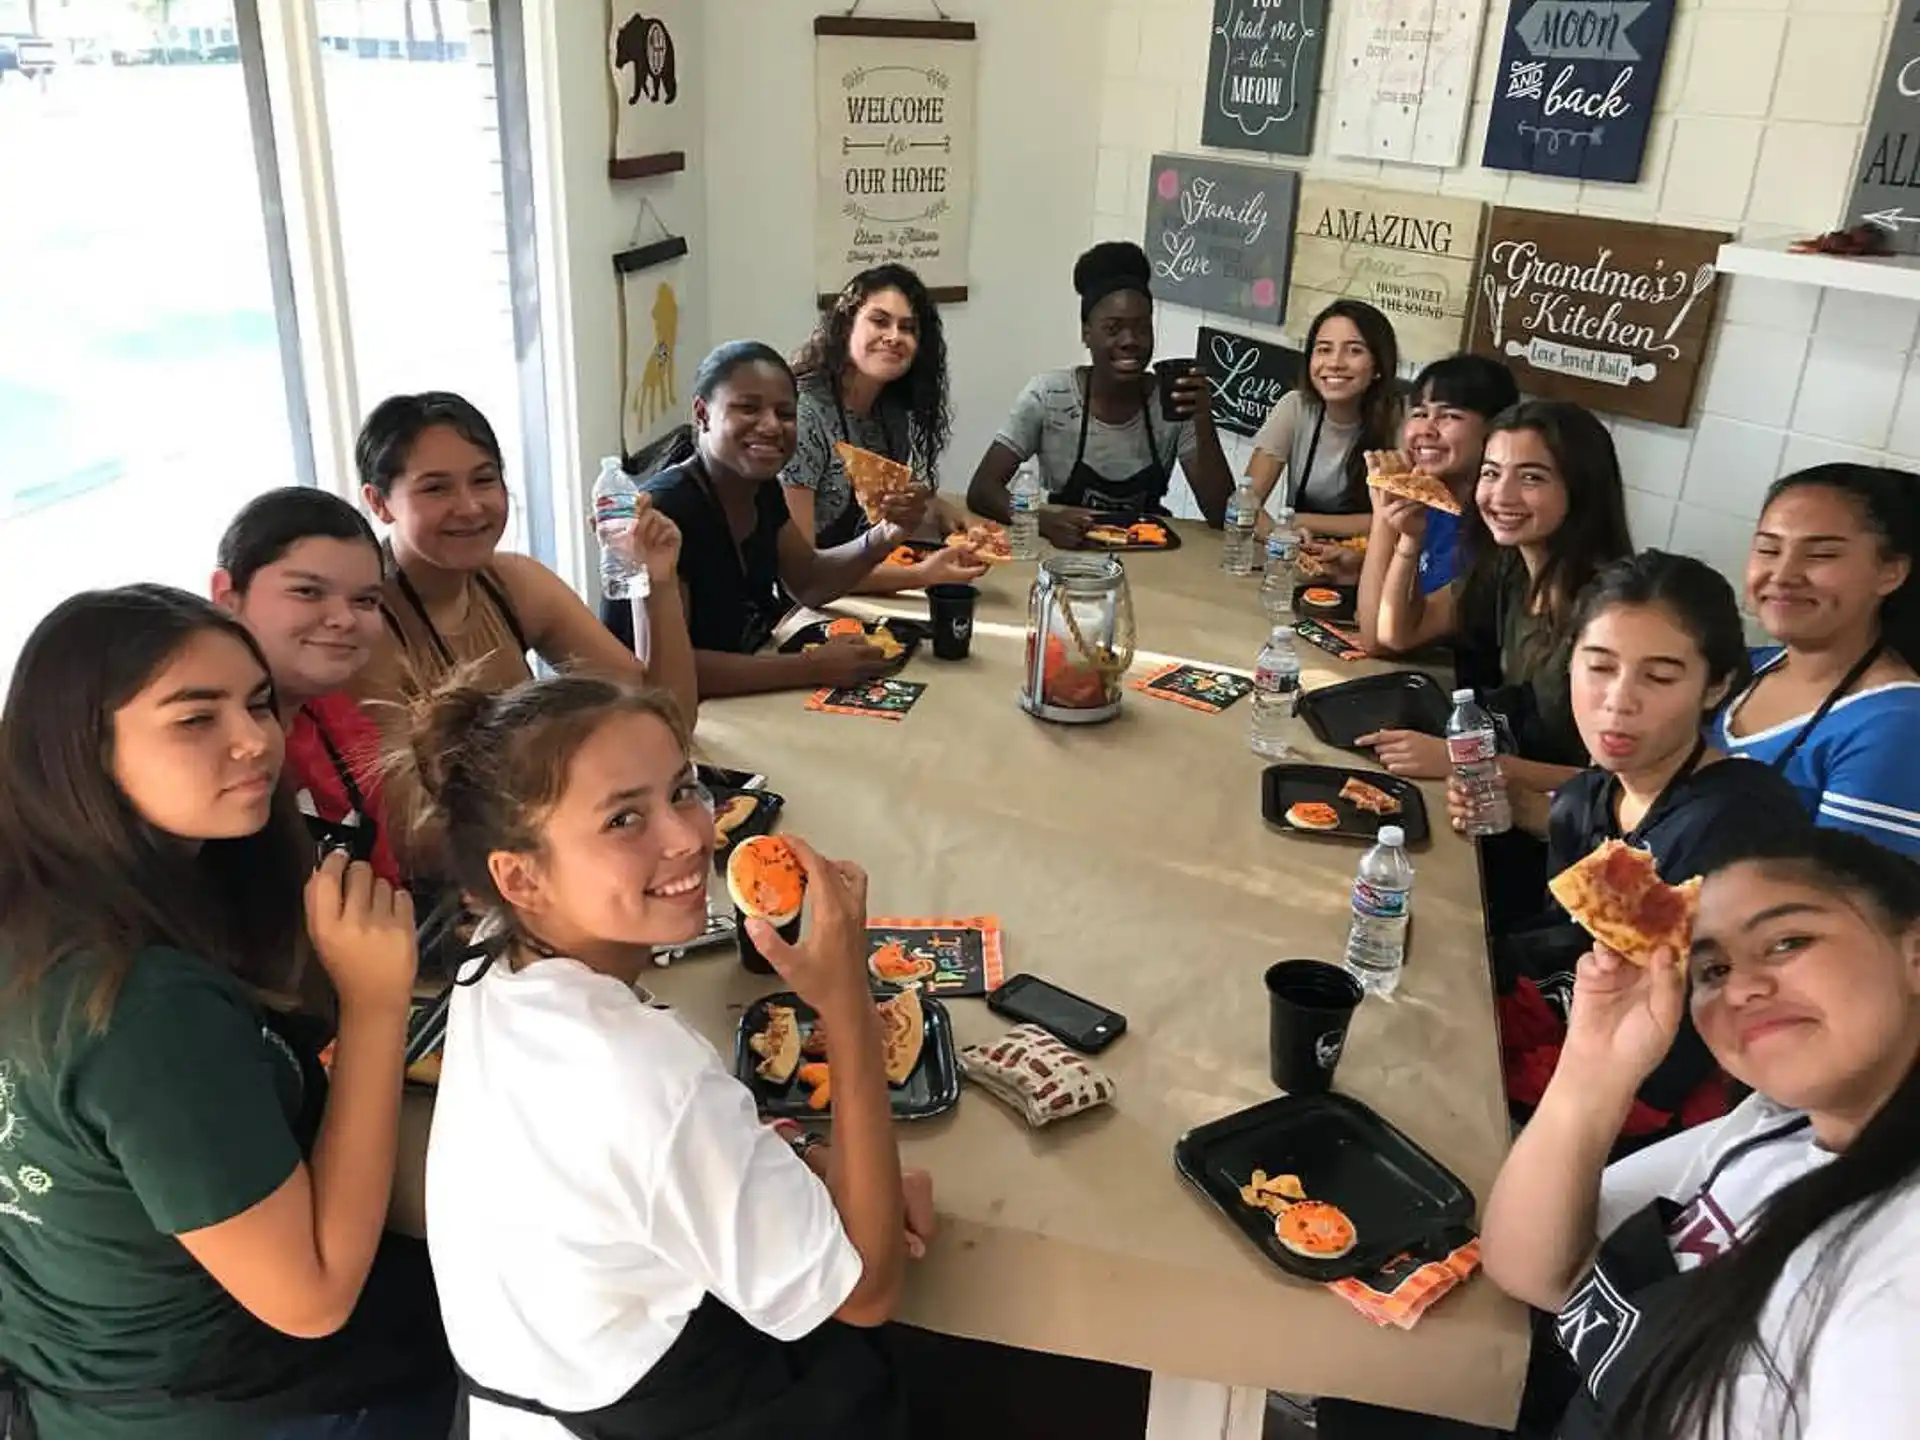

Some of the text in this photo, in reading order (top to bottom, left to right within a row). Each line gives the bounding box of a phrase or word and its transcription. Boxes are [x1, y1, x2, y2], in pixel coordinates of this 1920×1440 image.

[1232, 9, 1296, 41] had me
[1249, 42, 1269, 69] at
[1231, 75, 1283, 105] MEOW
[1507, 64, 1633, 118] AND back
[847, 96, 944, 124] WELCOME
[884, 133, 909, 156] to
[845, 167, 946, 194] OUR HOME
[1181, 177, 1268, 245] Family
[1314, 207, 1452, 253] AMAZING
[1155, 230, 1212, 281] Love
[1492, 240, 1687, 304] Grandma's
[1376, 280, 1443, 304] HOW SWEET
[1380, 296, 1443, 319] THE SOUND
[1522, 291, 1680, 360] Kitchen
[1205, 335, 1281, 404] Love
[1531, 341, 1630, 383] Love Served Daily
